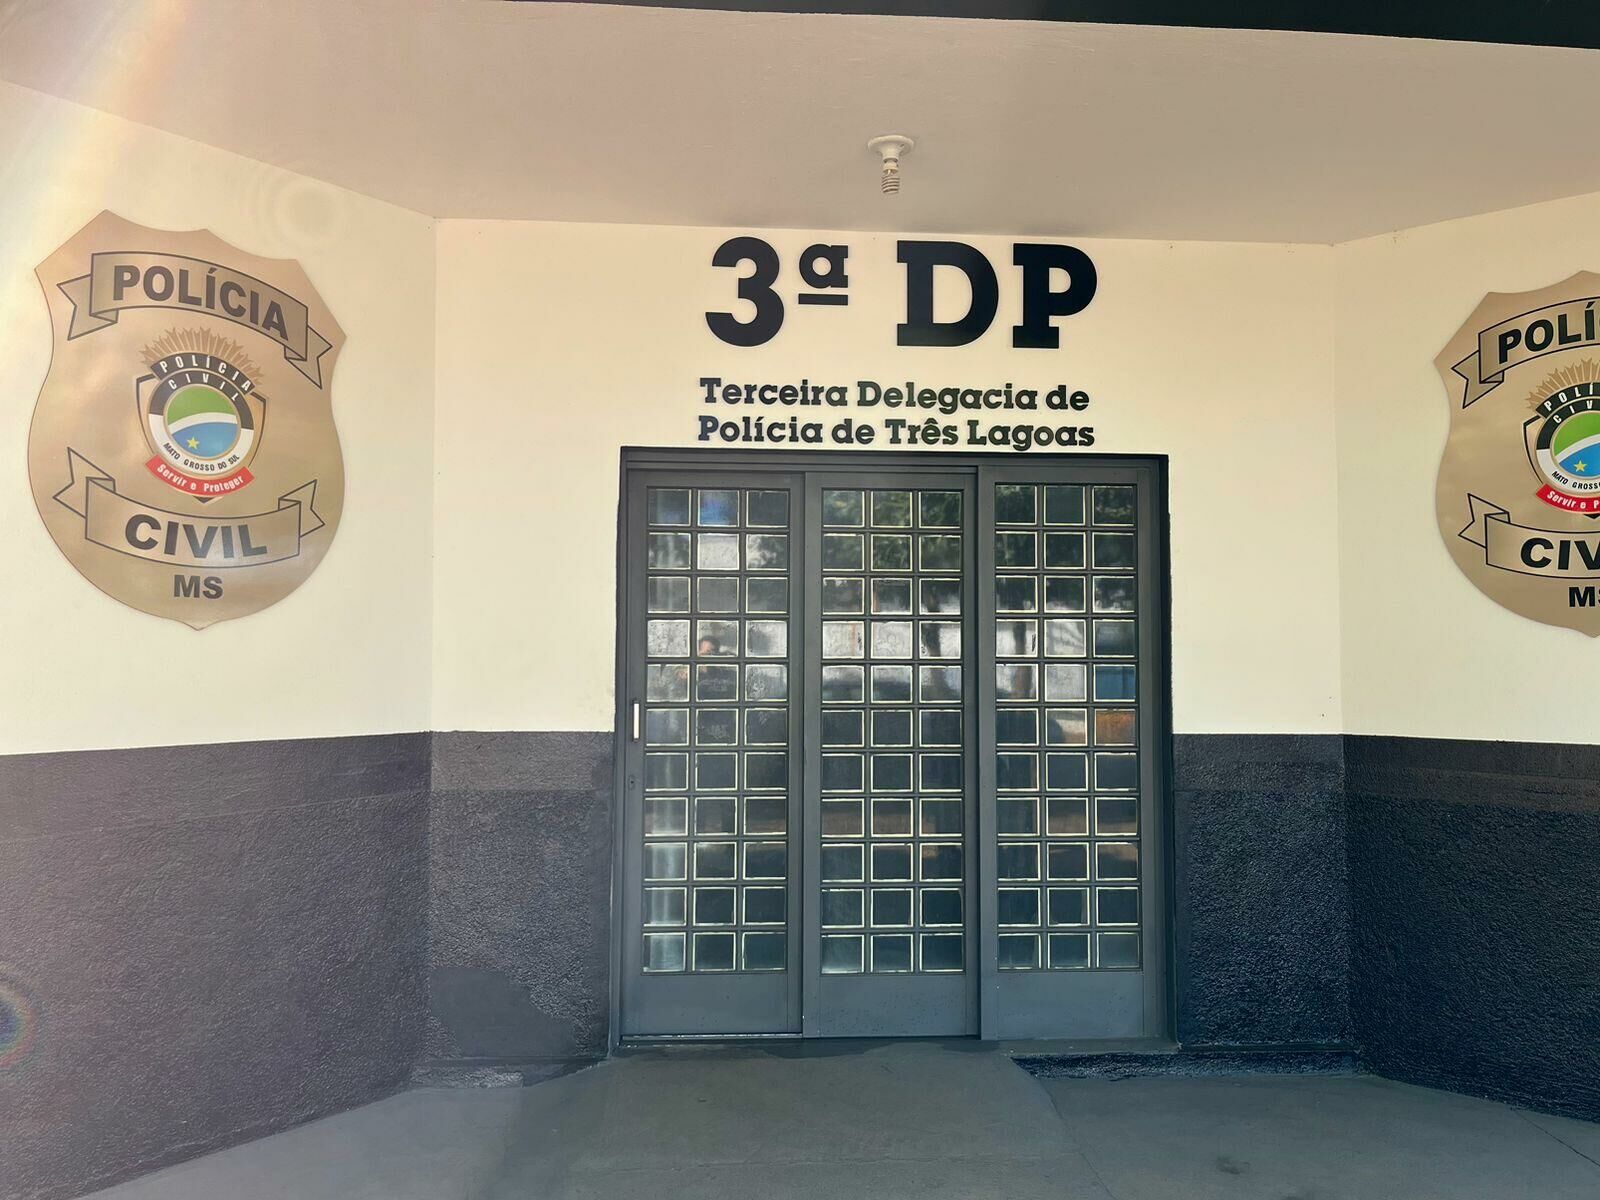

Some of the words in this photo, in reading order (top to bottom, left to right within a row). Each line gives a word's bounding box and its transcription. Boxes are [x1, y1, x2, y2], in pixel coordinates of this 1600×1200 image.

[113, 264, 289, 341] POLÍCIA
[897, 240, 1098, 349] DP
[1499, 301, 1600, 364] POLÍ
[159, 354, 252, 391] POLÍCIA
[168, 373, 239, 401] CIVIL
[700, 377, 849, 407] Terceira
[857, 380, 1038, 415] Delegacia
[1045, 384, 1090, 412] de
[698, 415, 823, 444] Polícia
[831, 418, 875, 445] de
[885, 418, 959, 446] Três
[967, 420, 1095, 451] Lagoas
[163, 442, 181, 460] MATO
[183, 458, 215, 472] GROSSO
[218, 461, 227, 470] DO
[228, 454, 240, 465] SUL
[156, 464, 188, 487] Servir
[190, 482, 197, 491] e
[203, 475, 244, 492] Proteger
[1551, 470, 1569, 485] MATO
[1572, 481, 1600, 490] GROSS
[1547, 490, 1576, 508] Servir
[1580, 501, 1586, 509] e
[124, 514, 268, 559] CIVIL
[173, 574, 224, 600] MS
[1568, 586, 1600, 608] M
